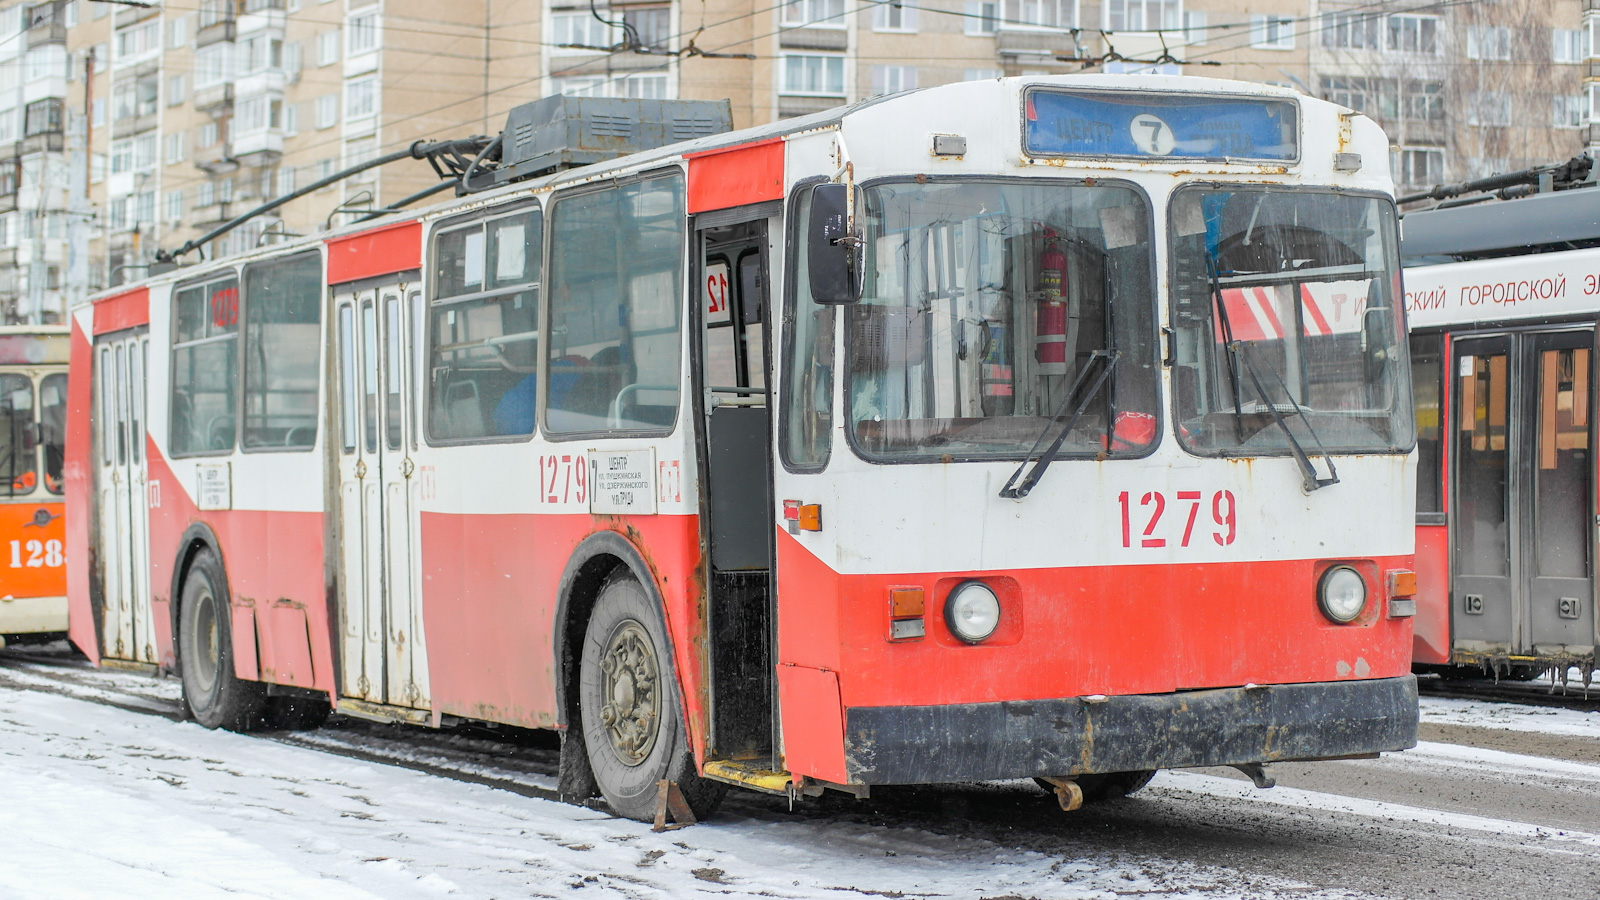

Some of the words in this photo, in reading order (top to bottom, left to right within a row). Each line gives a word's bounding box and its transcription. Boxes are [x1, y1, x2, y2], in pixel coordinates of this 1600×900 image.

[1056, 117, 1113, 143] ЦЕНТР
[1139, 121, 1162, 152] 7
[1460, 273, 1566, 307] ГОРОДСКОЙ
[211, 287, 239, 328] 1279
[608, 456, 628, 470] ЦЕНТР
[539, 455, 586, 504] 1279
[607, 481, 649, 490] ДЗЕРЖИНСКОГО
[1118, 489, 1236, 548] 1279
[9, 538, 69, 568] 128
